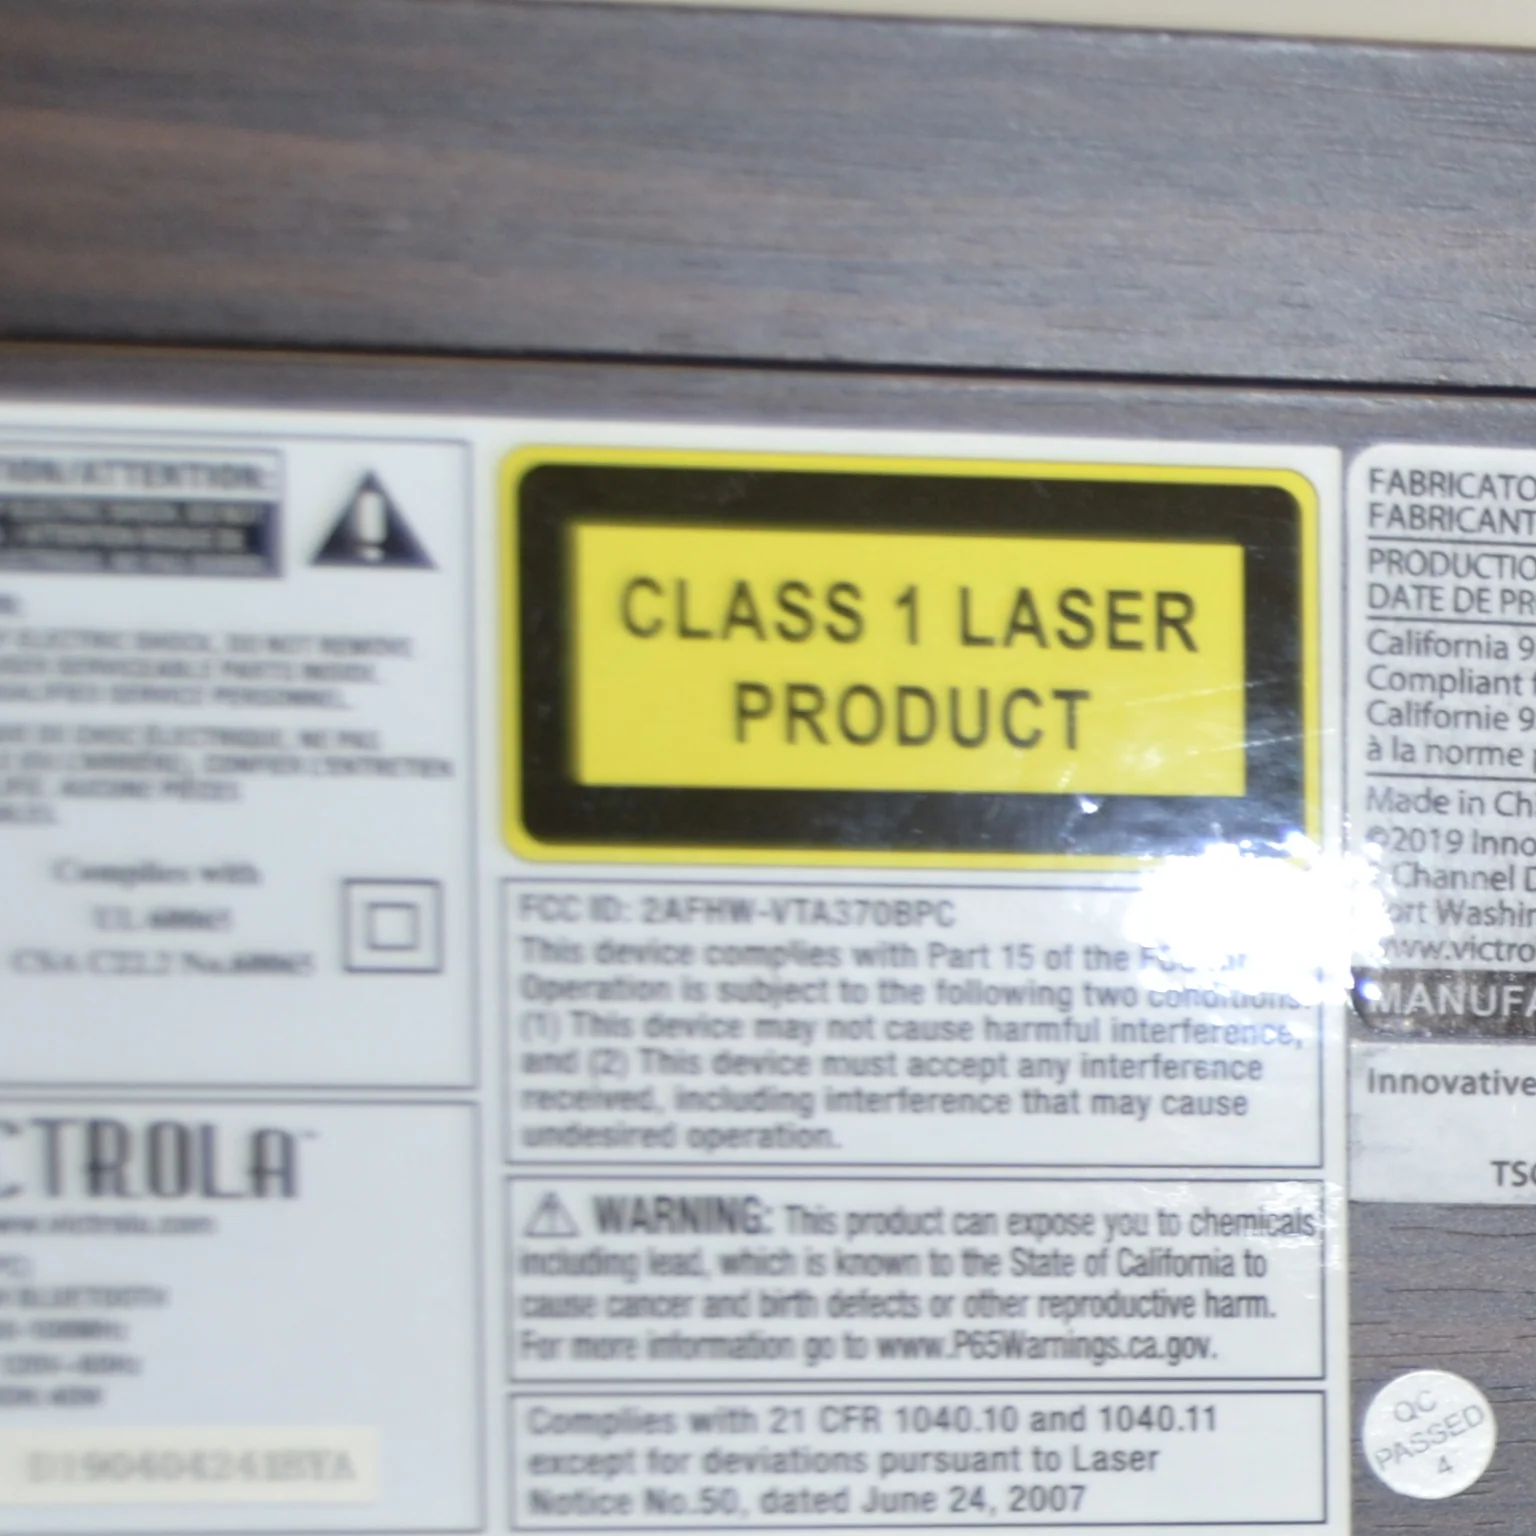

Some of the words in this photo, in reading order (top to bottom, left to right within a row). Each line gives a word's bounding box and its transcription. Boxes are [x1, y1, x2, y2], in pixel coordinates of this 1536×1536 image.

[619, 575, 864, 644] CLASS
[895, 583, 919, 645] 1
[958, 586, 1200, 652] LASER
[1367, 583, 1444, 612] DATE
[1452, 586, 1491, 615] DE
[1366, 627, 1509, 660] California
[1364, 663, 1523, 702] Compliant
[733, 680, 1090, 750] PRODUCT
[1364, 698, 1510, 731] Californie
[1365, 737, 1382, 762] à
[1390, 737, 1416, 763] la
[1423, 743, 1523, 767] norme
[1365, 785, 1450, 815] Made
[1457, 788, 1485, 815] in
[1392, 863, 1515, 892] Channel
[1384, 901, 1426, 924] ort
[702, 940, 841, 970] complies
[850, 941, 917, 968] with
[926, 940, 990, 969] Part
[1001, 942, 1034, 970] 15
[1043, 943, 1073, 971] of
[1081, 945, 1130, 972] the
[715, 976, 830, 1008] subject
[836, 979, 869, 1004] to
[876, 978, 926, 1006] the
[934, 977, 1074, 1014] following
[1081, 982, 1140, 1008] two
[752, 1017, 817, 1045] may
[825, 1015, 876, 1041] not
[883, 1018, 975, 1042] cause
[982, 1015, 1100, 1044] harmful
[710, 1050, 812, 1076] device
[819, 1052, 898, 1077] must
[905, 1053, 1008, 1082] accept
[1016, 1056, 1071, 1085] any
[1079, 1051, 1263, 1081] interference
[823, 1086, 1011, 1115] interference
[1019, 1088, 1080, 1115] that
[1089, 1092, 1151, 1121] may
[1160, 1093, 1248, 1116] cause
[784, 1203, 838, 1236] This
[844, 1207, 944, 1238] product
[951, 1210, 998, 1236] can
[1005, 1211, 1095, 1240] expose
[1102, 1211, 1149, 1244] you
[1155, 1207, 1181, 1237] to
[1188, 1206, 1317, 1238] chemicals
[718, 1249, 796, 1277] which
[833, 1250, 920, 1277] known
[927, 1249, 953, 1277] to
[959, 1247, 1002, 1277] the
[1009, 1247, 1076, 1277] State
[1083, 1248, 1109, 1277] of
[1116, 1248, 1236, 1278] California
[1242, 1248, 1268, 1278] to
[825, 1288, 922, 1318] defects
[928, 1294, 955, 1318] or
[962, 1288, 1030, 1318] other
[1037, 1288, 1196, 1321] reproductive
[802, 1335, 836, 1367] go
[841, 1333, 868, 1359] to
[768, 1405, 804, 1435] 21
[818, 1403, 881, 1434] CFR
[895, 1404, 1019, 1433] 1040.10
[1029, 1404, 1087, 1433] and
[1099, 1403, 1216, 1432] 1040.11
[1393, 1389, 1437, 1423] QC
[1374, 1404, 1486, 1472] PASSED
[700, 1447, 869, 1475] deviations
[877, 1445, 1021, 1478] pursuant
[1030, 1445, 1062, 1473] to
[1071, 1444, 1159, 1472] Laser
[758, 1486, 849, 1515] dated
[860, 1486, 937, 1514] June
[1007, 1483, 1086, 1513] 2007
